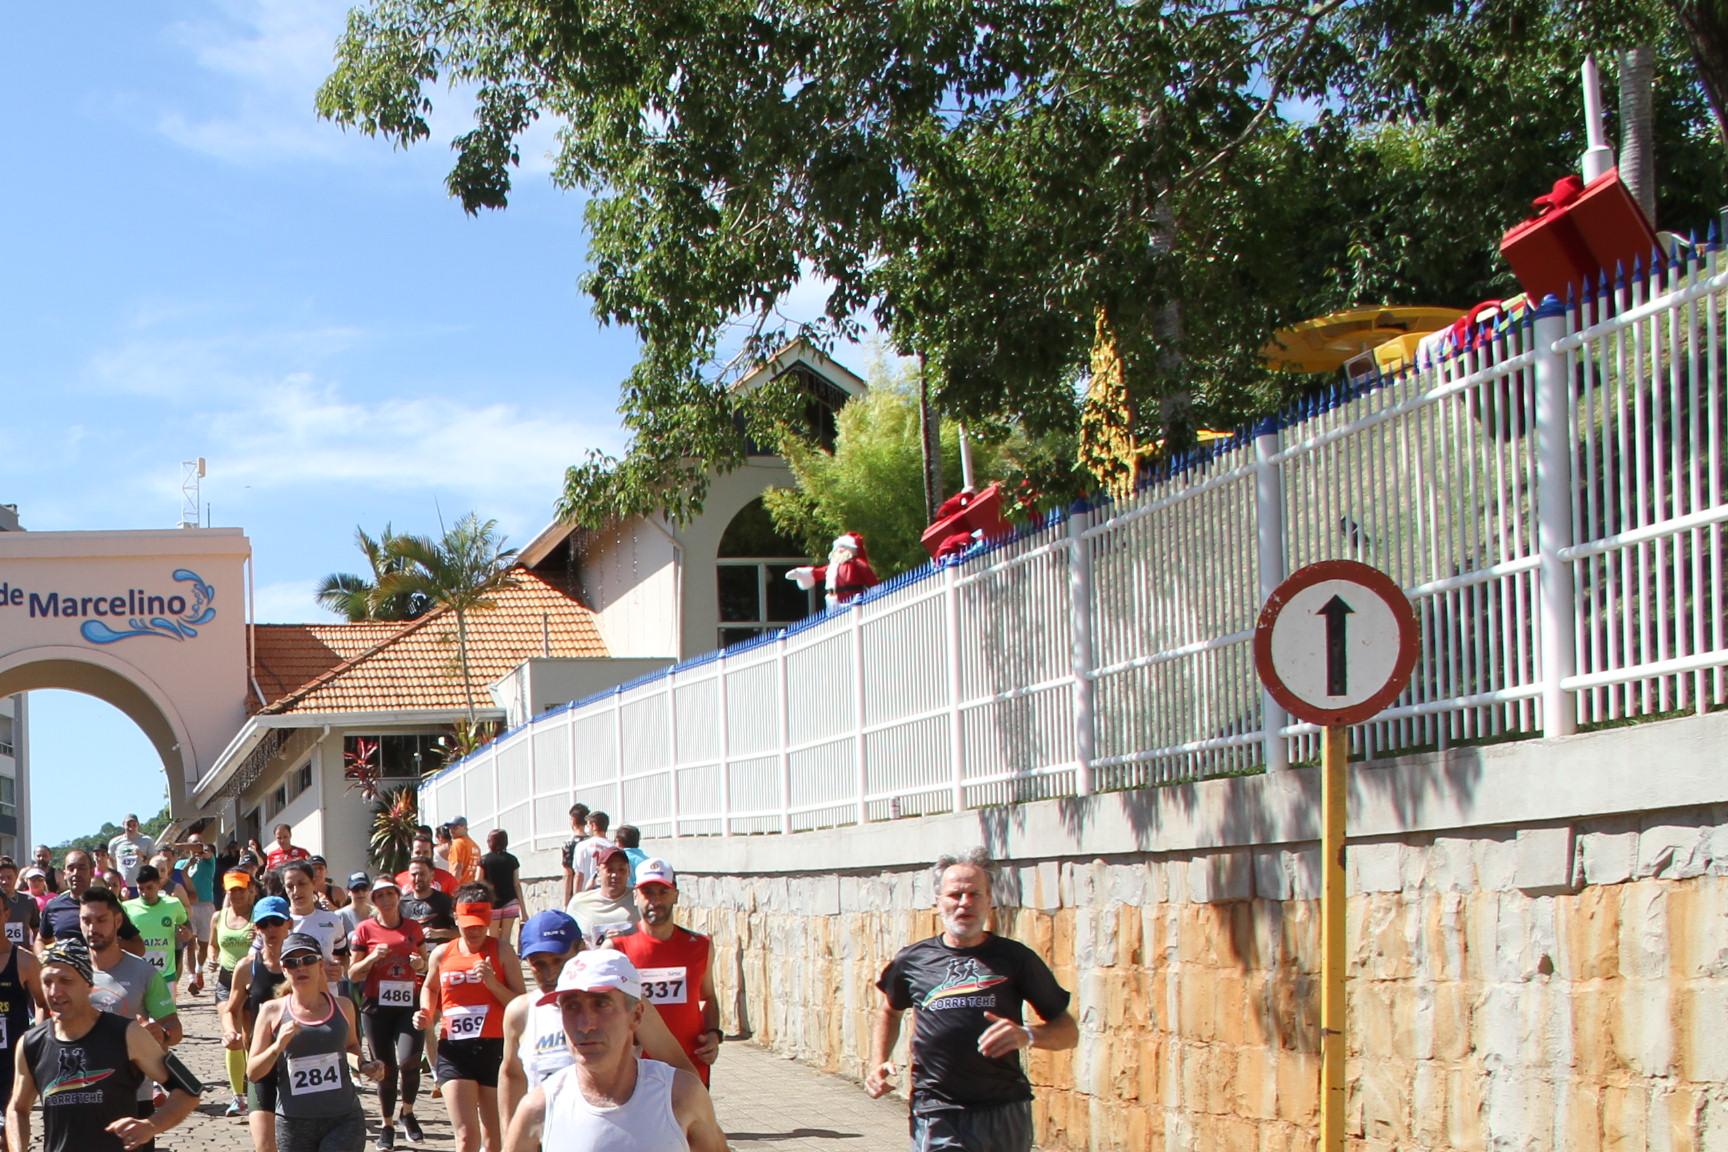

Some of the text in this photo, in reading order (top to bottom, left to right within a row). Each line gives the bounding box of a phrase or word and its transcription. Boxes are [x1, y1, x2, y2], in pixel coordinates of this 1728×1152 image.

[29, 589, 186, 619] Marcelino
[143, 937, 169, 947] AIXA
[382, 989, 411, 1003] 486
[640, 980, 683, 998] 337
[451, 1016, 484, 1034] 569
[294, 1066, 338, 1089] 284
